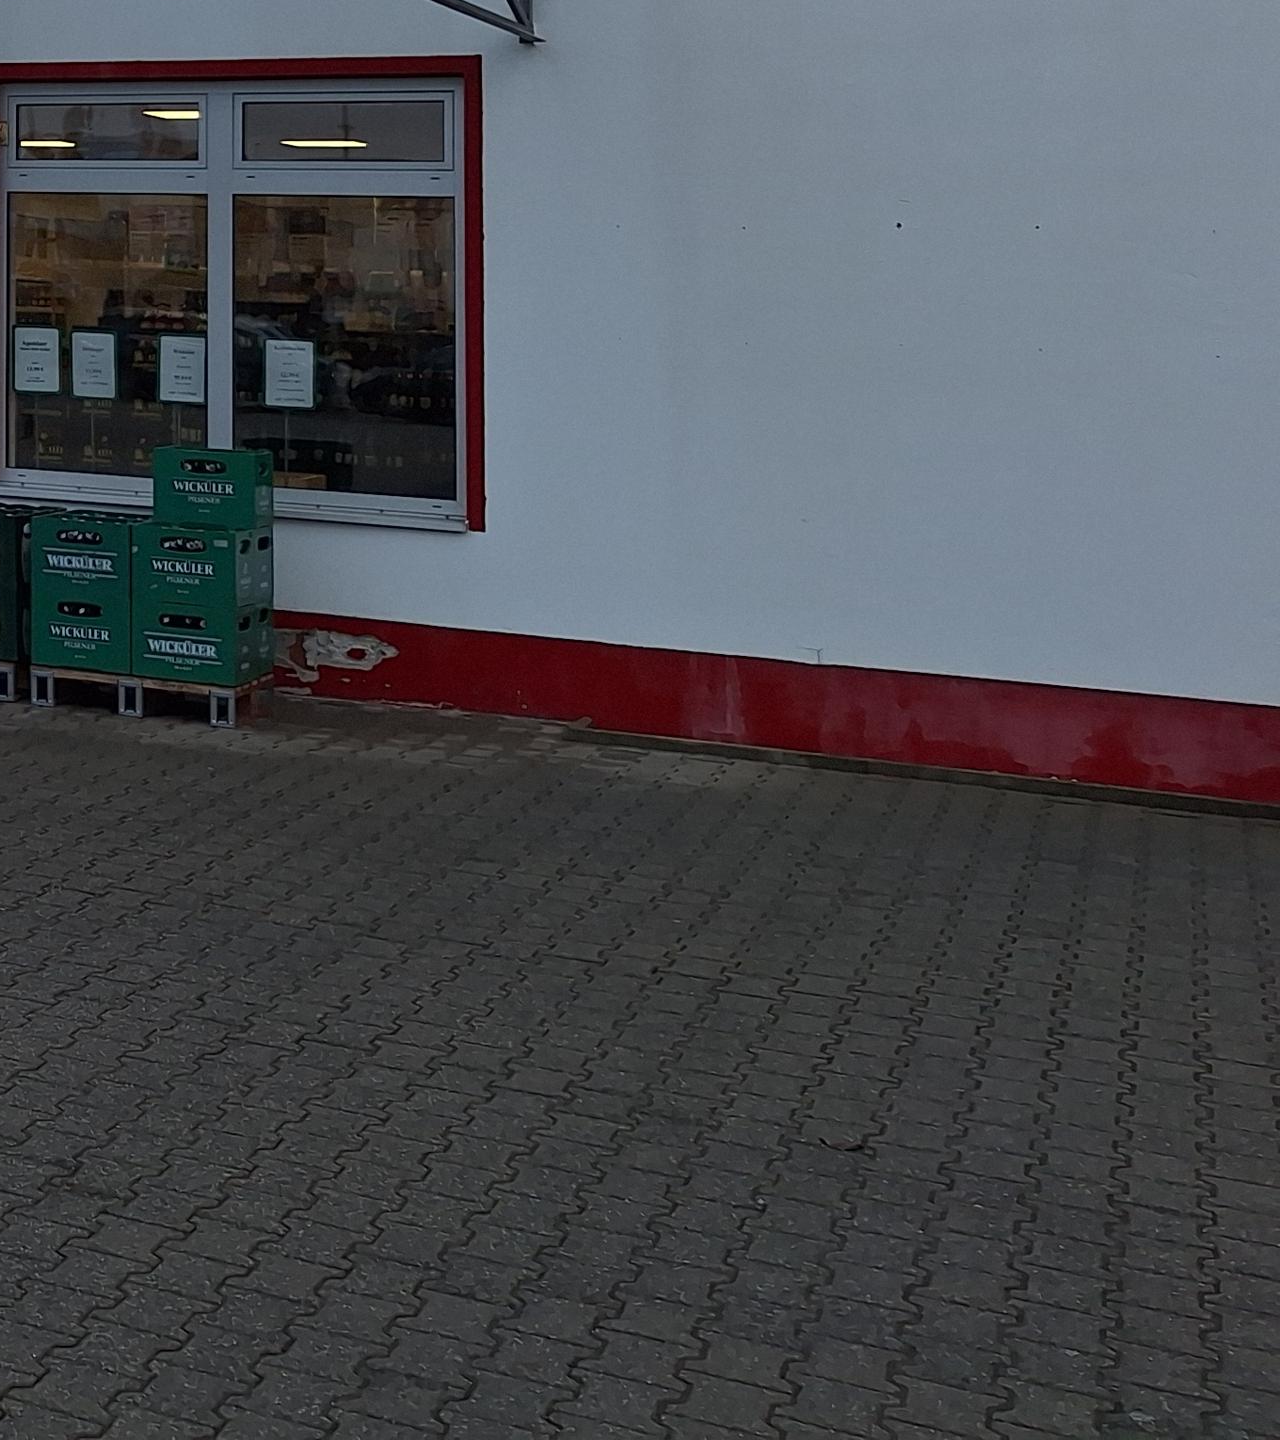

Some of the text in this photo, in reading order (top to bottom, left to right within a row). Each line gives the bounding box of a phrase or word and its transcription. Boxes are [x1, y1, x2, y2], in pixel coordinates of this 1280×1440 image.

[173, 480, 234, 495] WICKÜLER
[47, 553, 113, 572] WICKÜLER
[152, 559, 214, 575] WICKÜLER
[147, 638, 218, 658] WICKÜLER
